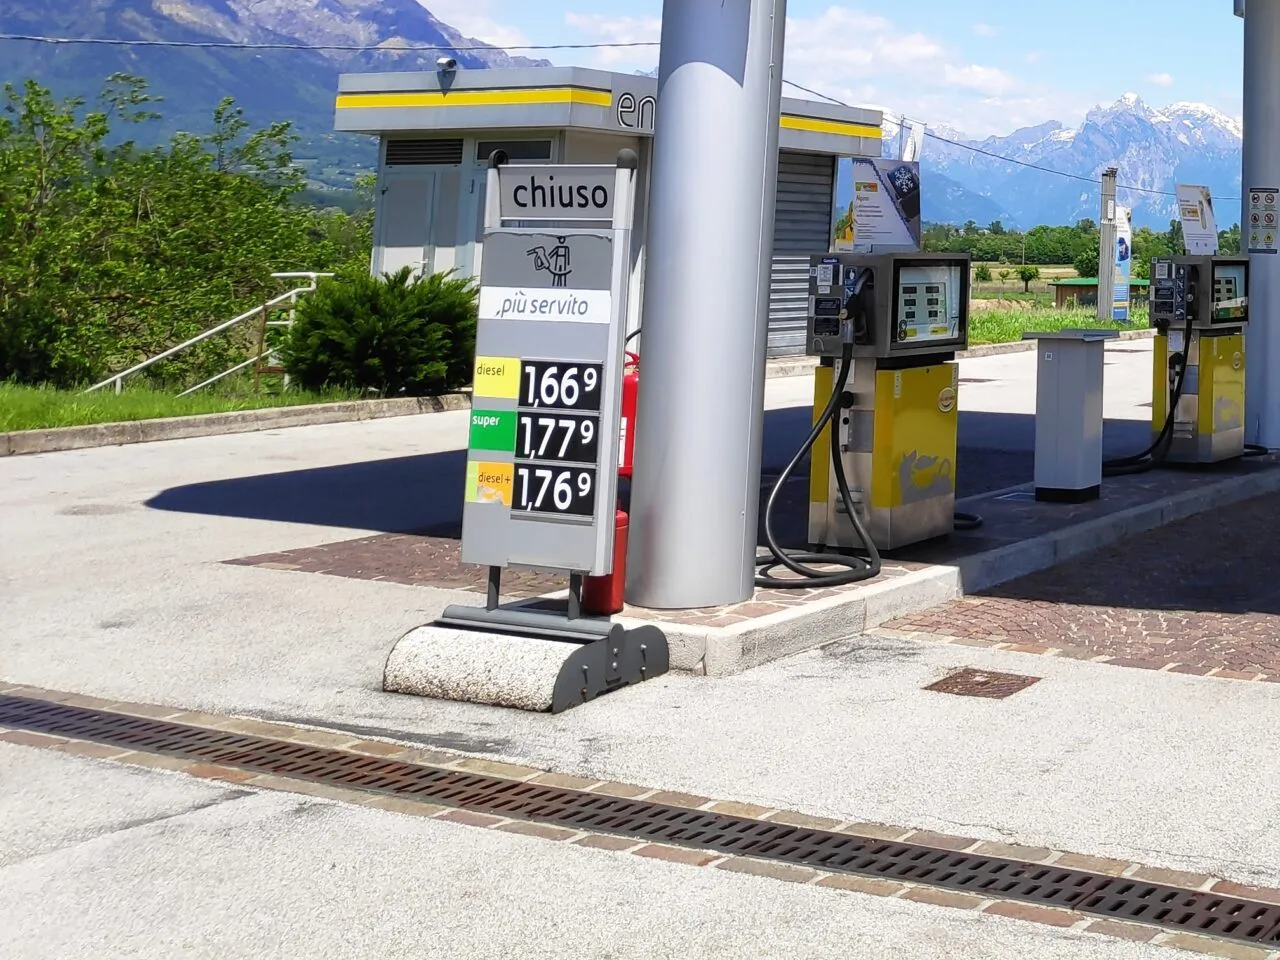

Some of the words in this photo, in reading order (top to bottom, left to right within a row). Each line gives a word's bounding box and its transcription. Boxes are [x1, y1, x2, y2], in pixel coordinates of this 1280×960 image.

[617, 92, 657, 130] en
[513, 176, 608, 208] chiuso
[530, 294, 589, 316] servito
[477, 364, 505, 376] diesel
[473, 415, 500, 427] super
